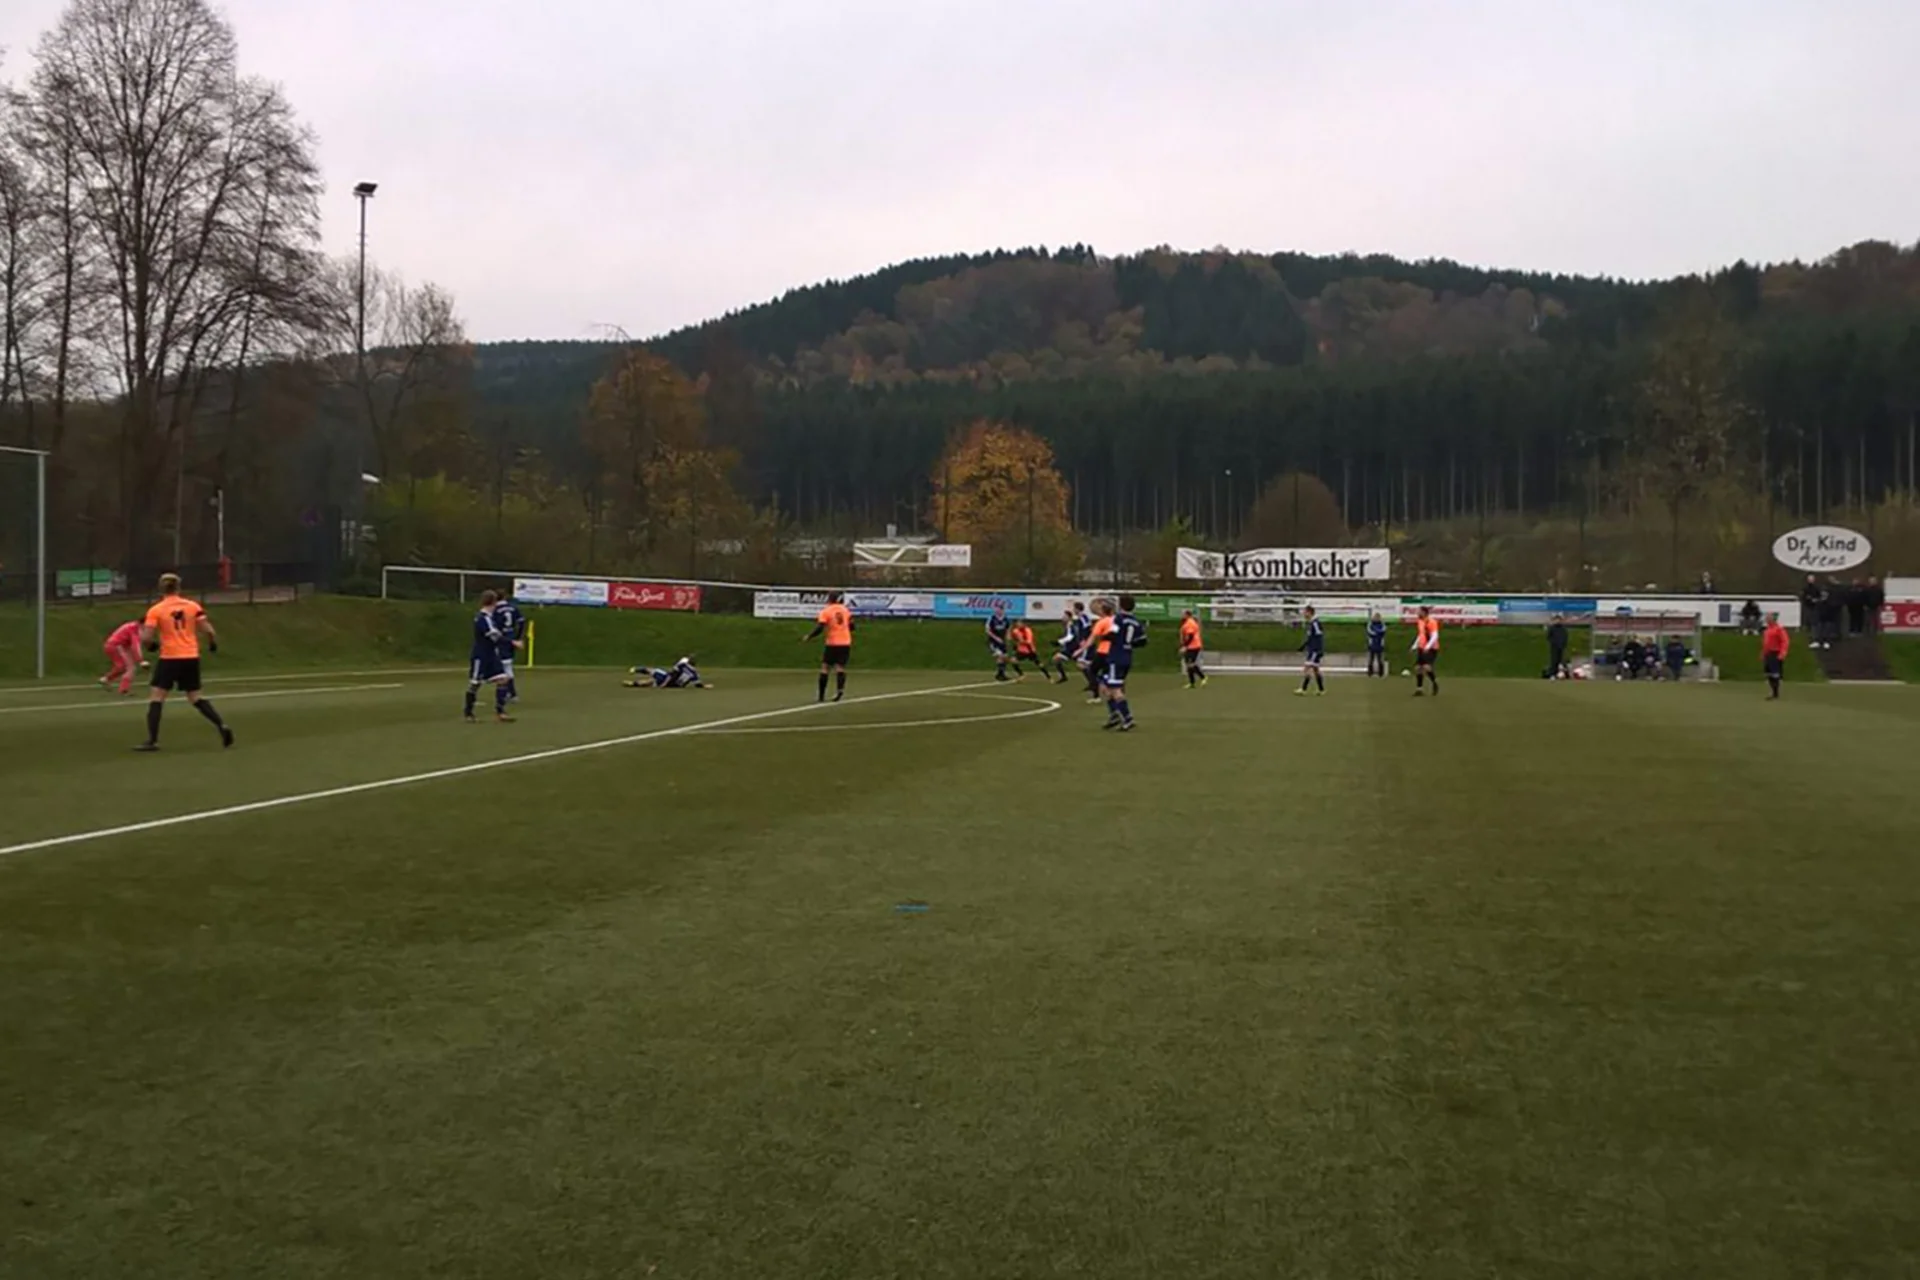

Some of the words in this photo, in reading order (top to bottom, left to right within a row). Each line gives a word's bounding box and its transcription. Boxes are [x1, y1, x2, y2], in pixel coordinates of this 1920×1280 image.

[1787, 536, 1811, 552] Dr.
[1817, 534, 1858, 552] Kind
[1223, 551, 1371, 579] Krombacher
